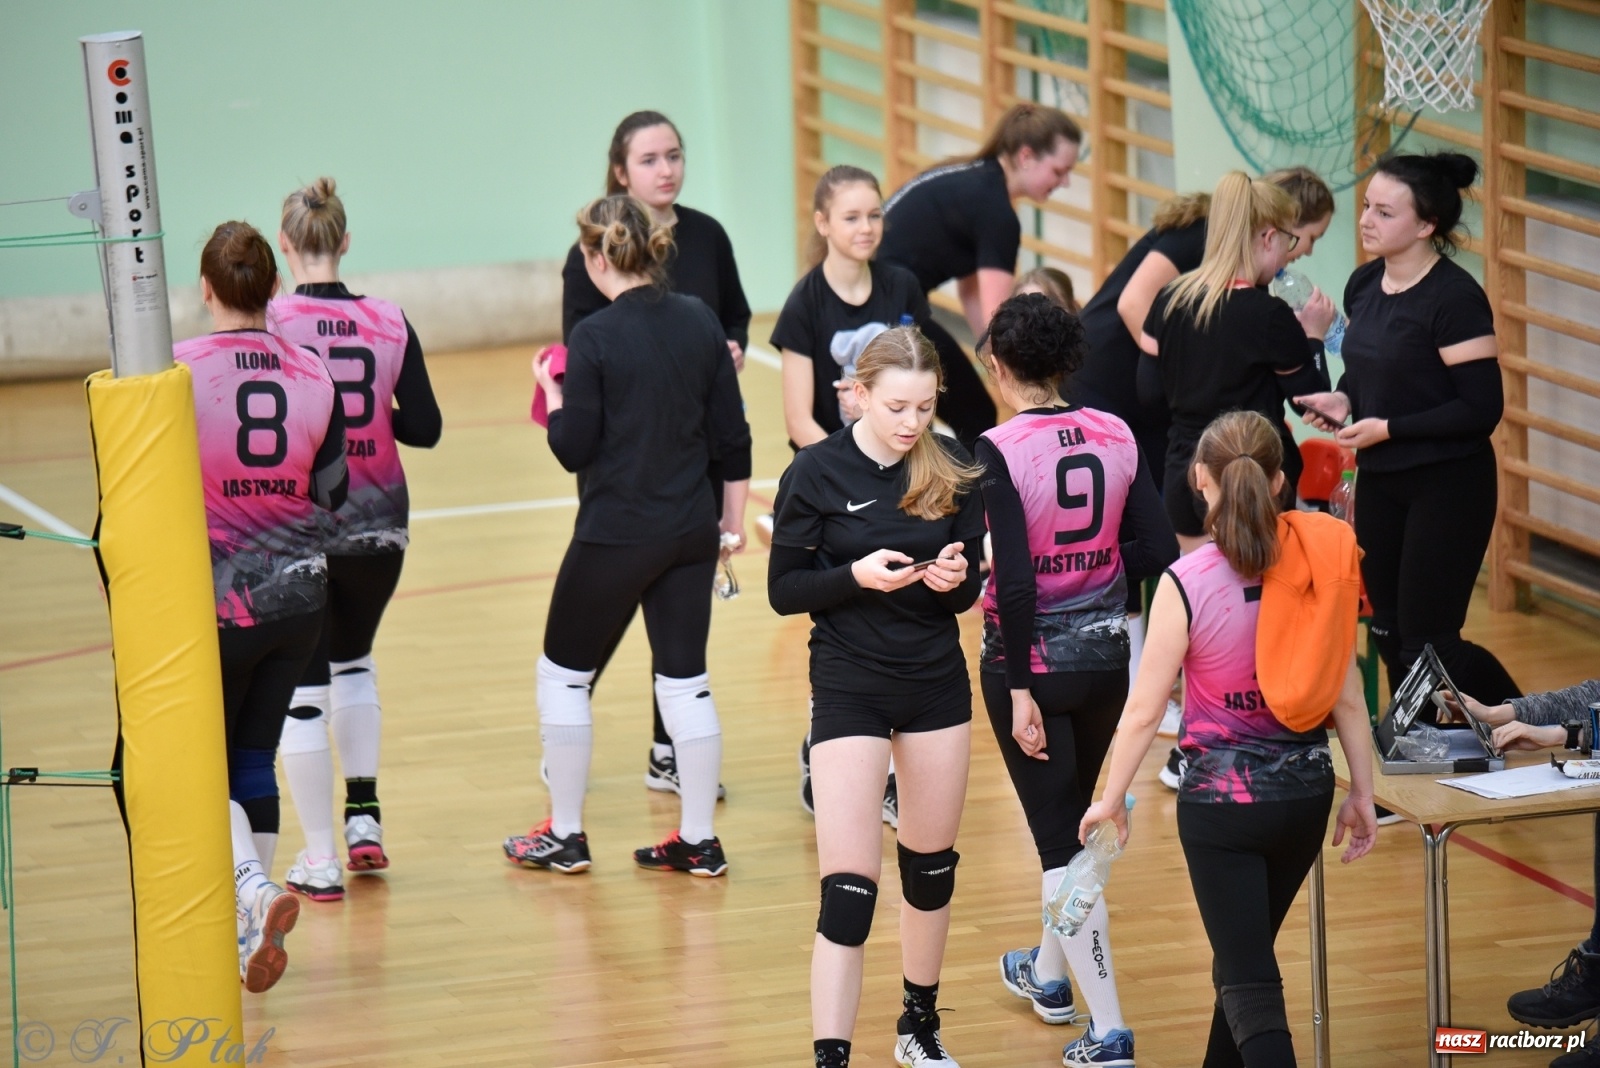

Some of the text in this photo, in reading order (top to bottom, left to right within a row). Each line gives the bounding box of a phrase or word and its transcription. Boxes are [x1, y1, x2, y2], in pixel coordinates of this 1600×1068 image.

[317, 319, 358, 337] OLGA
[235, 352, 282, 371] ILONA
[236, 380, 288, 467] 8
[1057, 426, 1087, 448] ELA
[1054, 452, 1106, 545] 9
